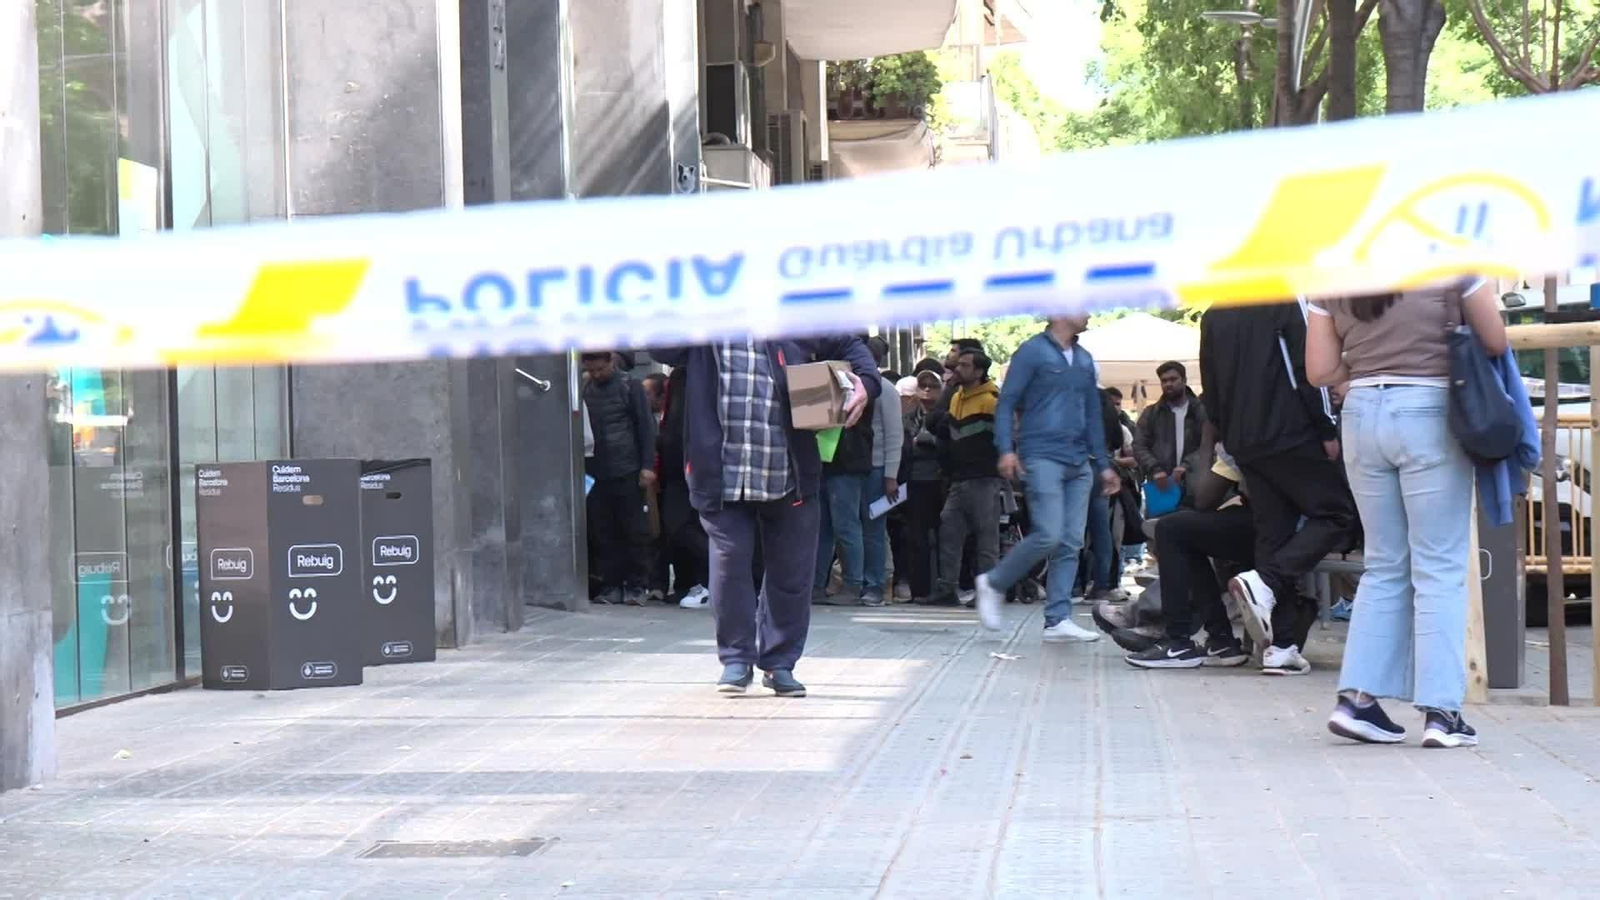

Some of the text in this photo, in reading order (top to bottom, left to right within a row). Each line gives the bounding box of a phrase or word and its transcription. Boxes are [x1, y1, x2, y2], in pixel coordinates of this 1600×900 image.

[272, 465, 301, 474] Cuidem
[379, 545, 412, 560] Rebuig
[217, 558, 247, 573] Rebuig
[297, 554, 335, 570] Rebuig
